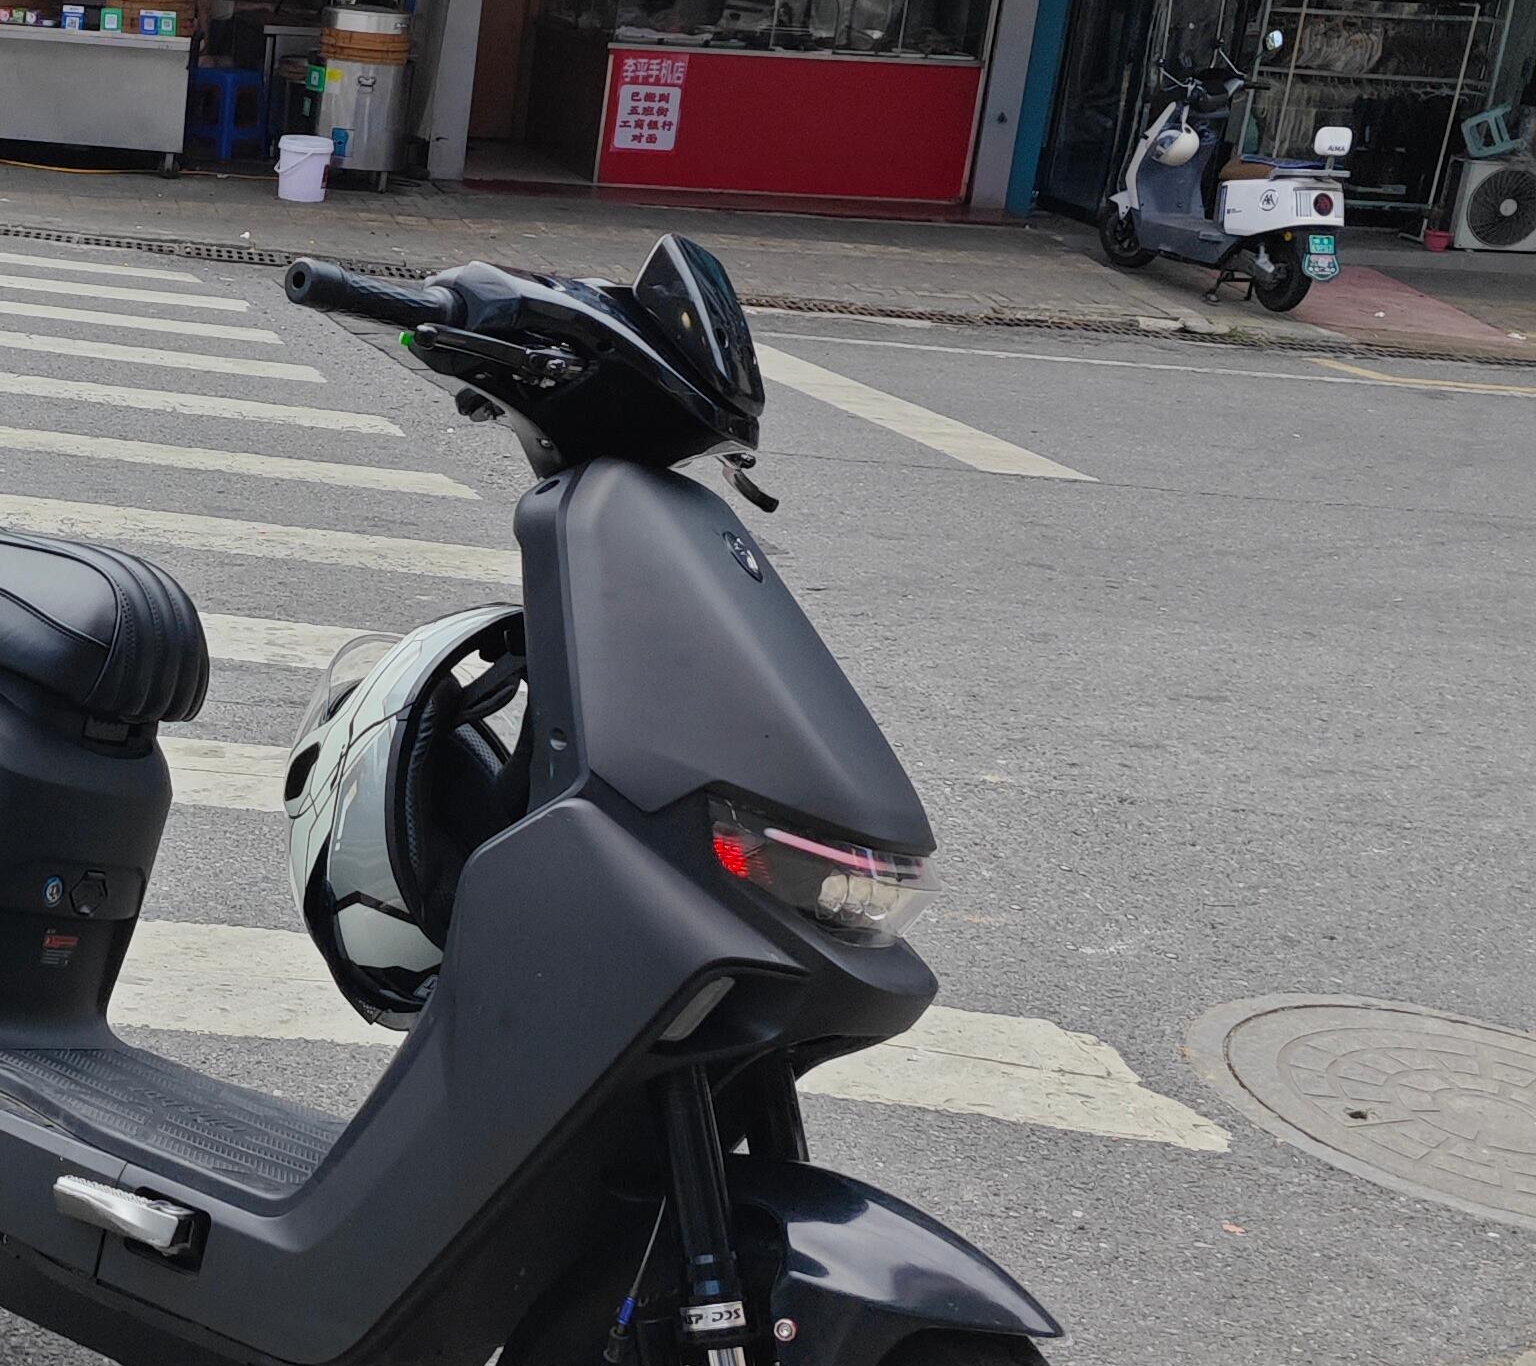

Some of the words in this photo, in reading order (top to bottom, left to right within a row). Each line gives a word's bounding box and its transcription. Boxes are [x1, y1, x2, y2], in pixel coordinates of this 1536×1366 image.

[623, 58, 685, 84] 李平手机店
[619, 119, 673, 131] 工商银行
[630, 133, 658, 144] 对面
